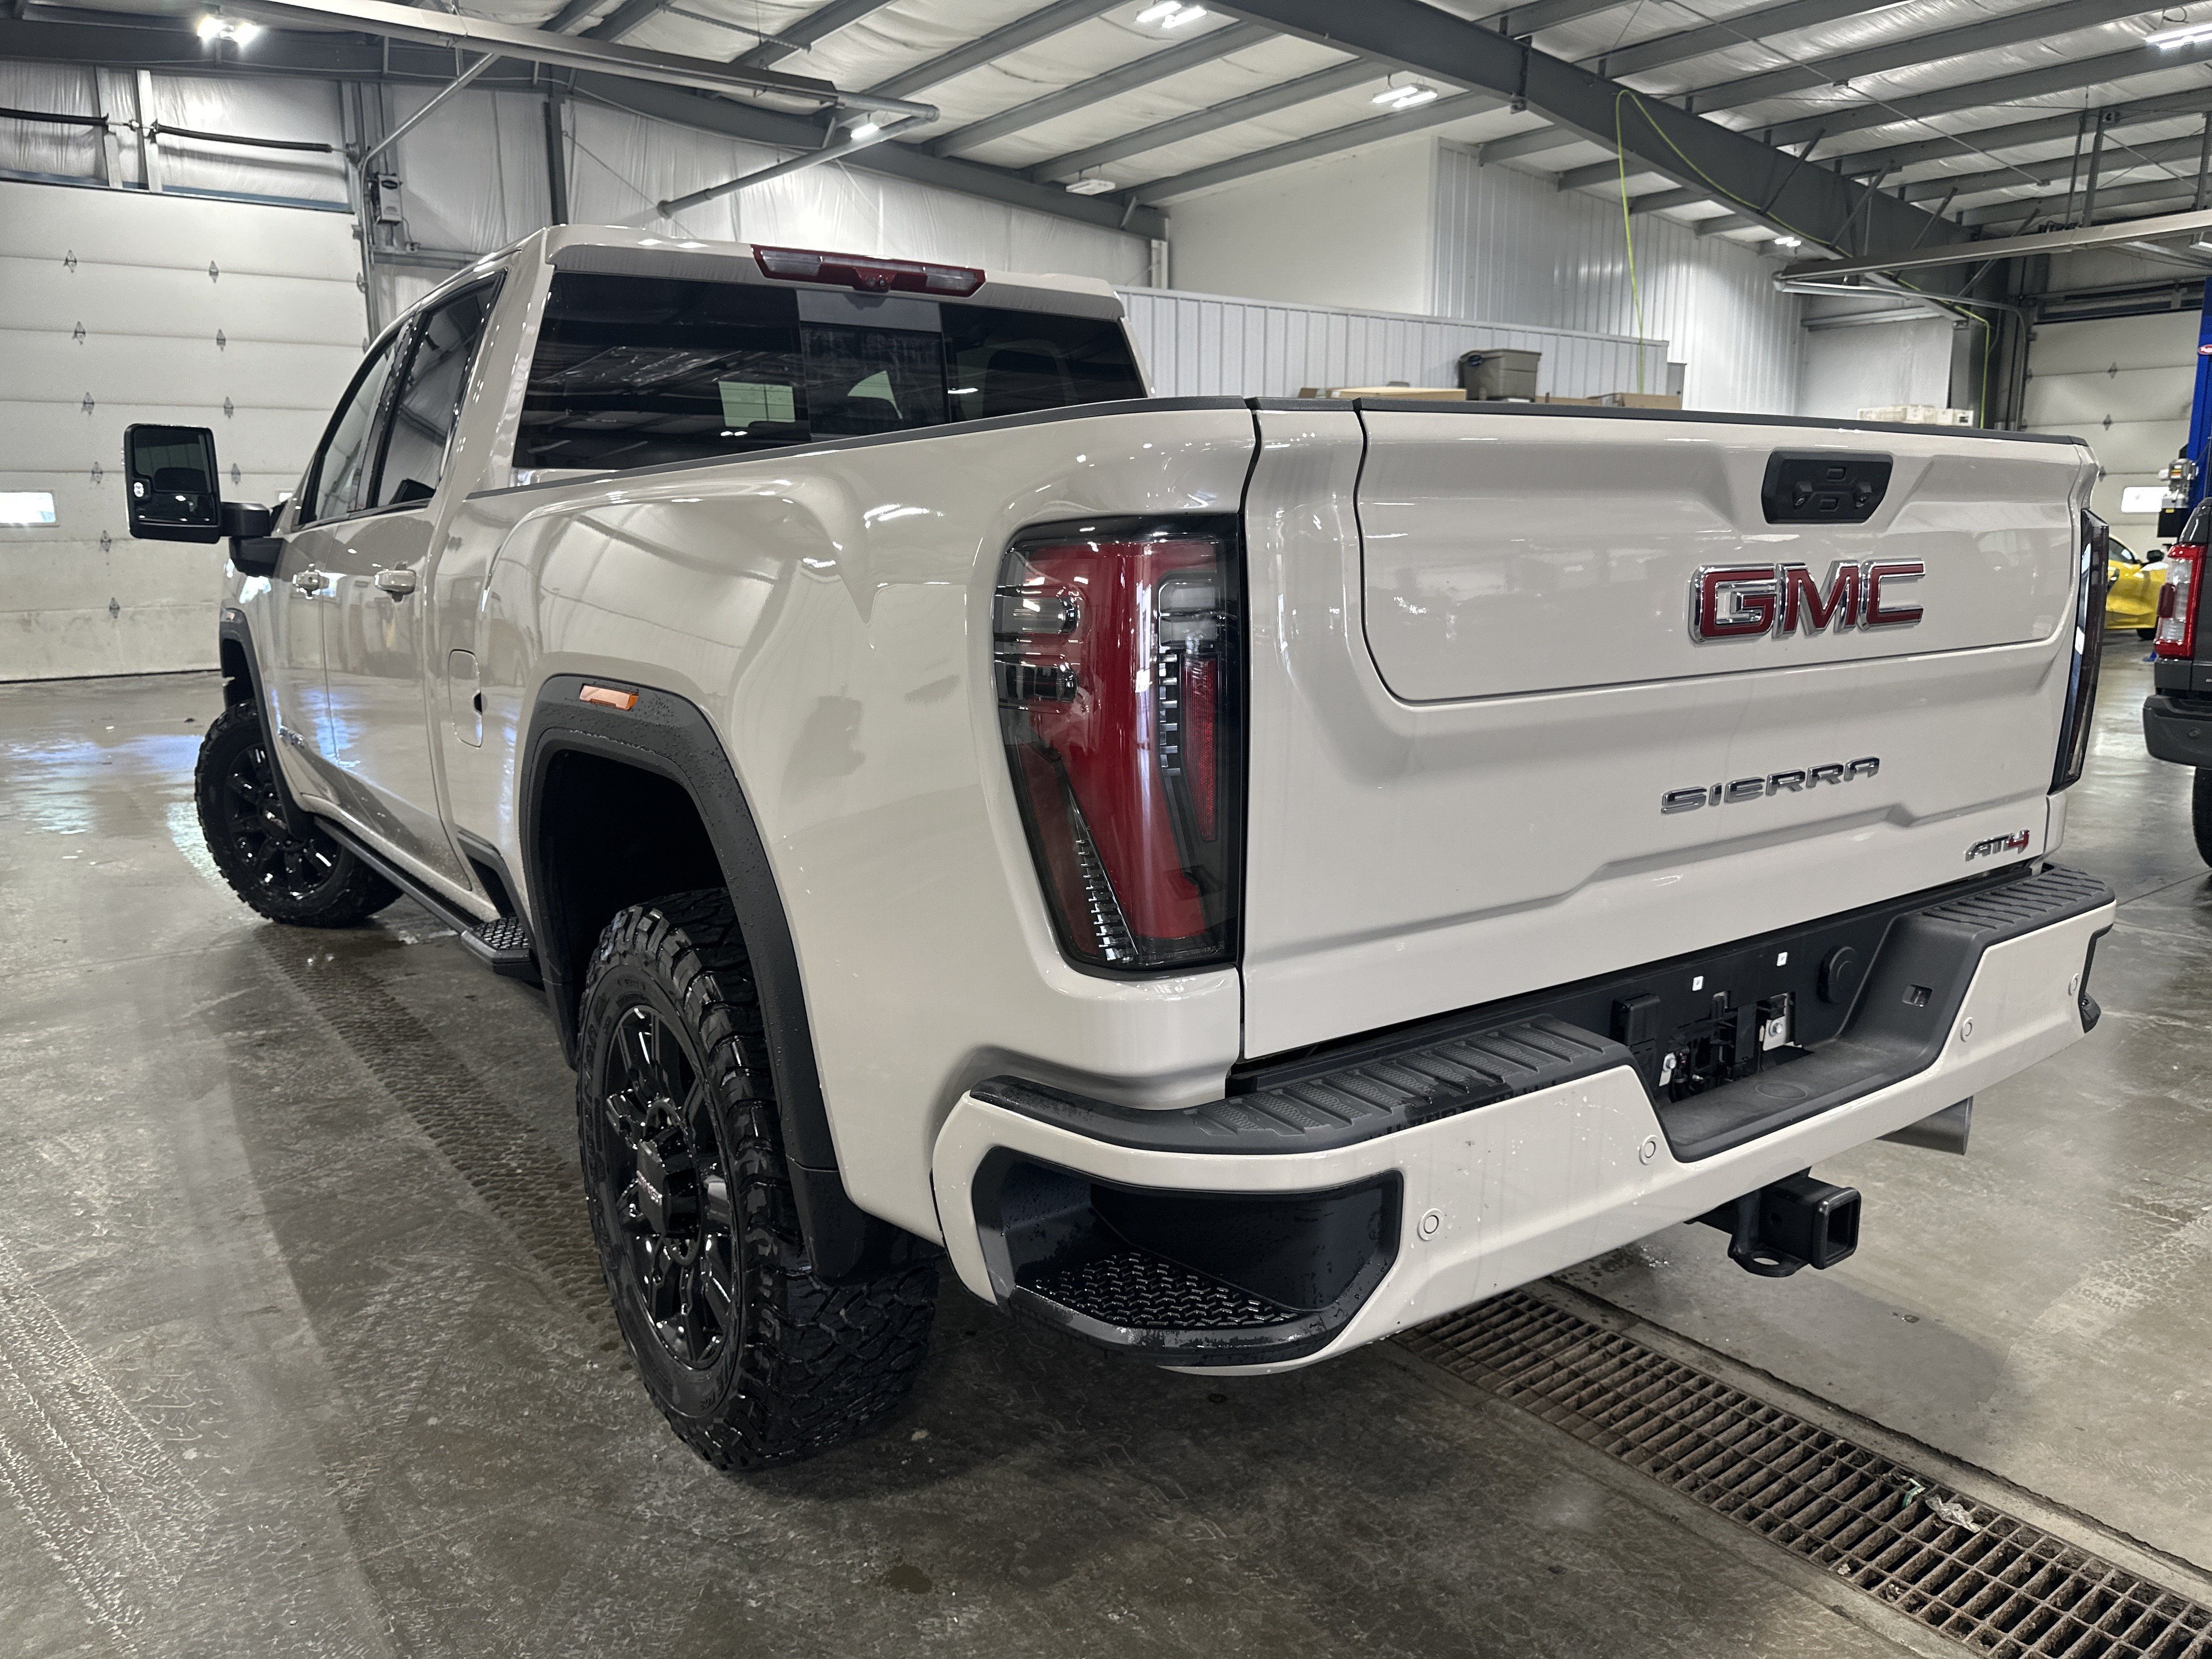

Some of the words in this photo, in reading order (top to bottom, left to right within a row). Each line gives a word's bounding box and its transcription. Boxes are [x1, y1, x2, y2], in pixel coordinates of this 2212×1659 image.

[1688, 558, 1925, 644] GMC
[1661, 756, 1880, 815] SIERRA
[1965, 828, 2029, 862] AT4
